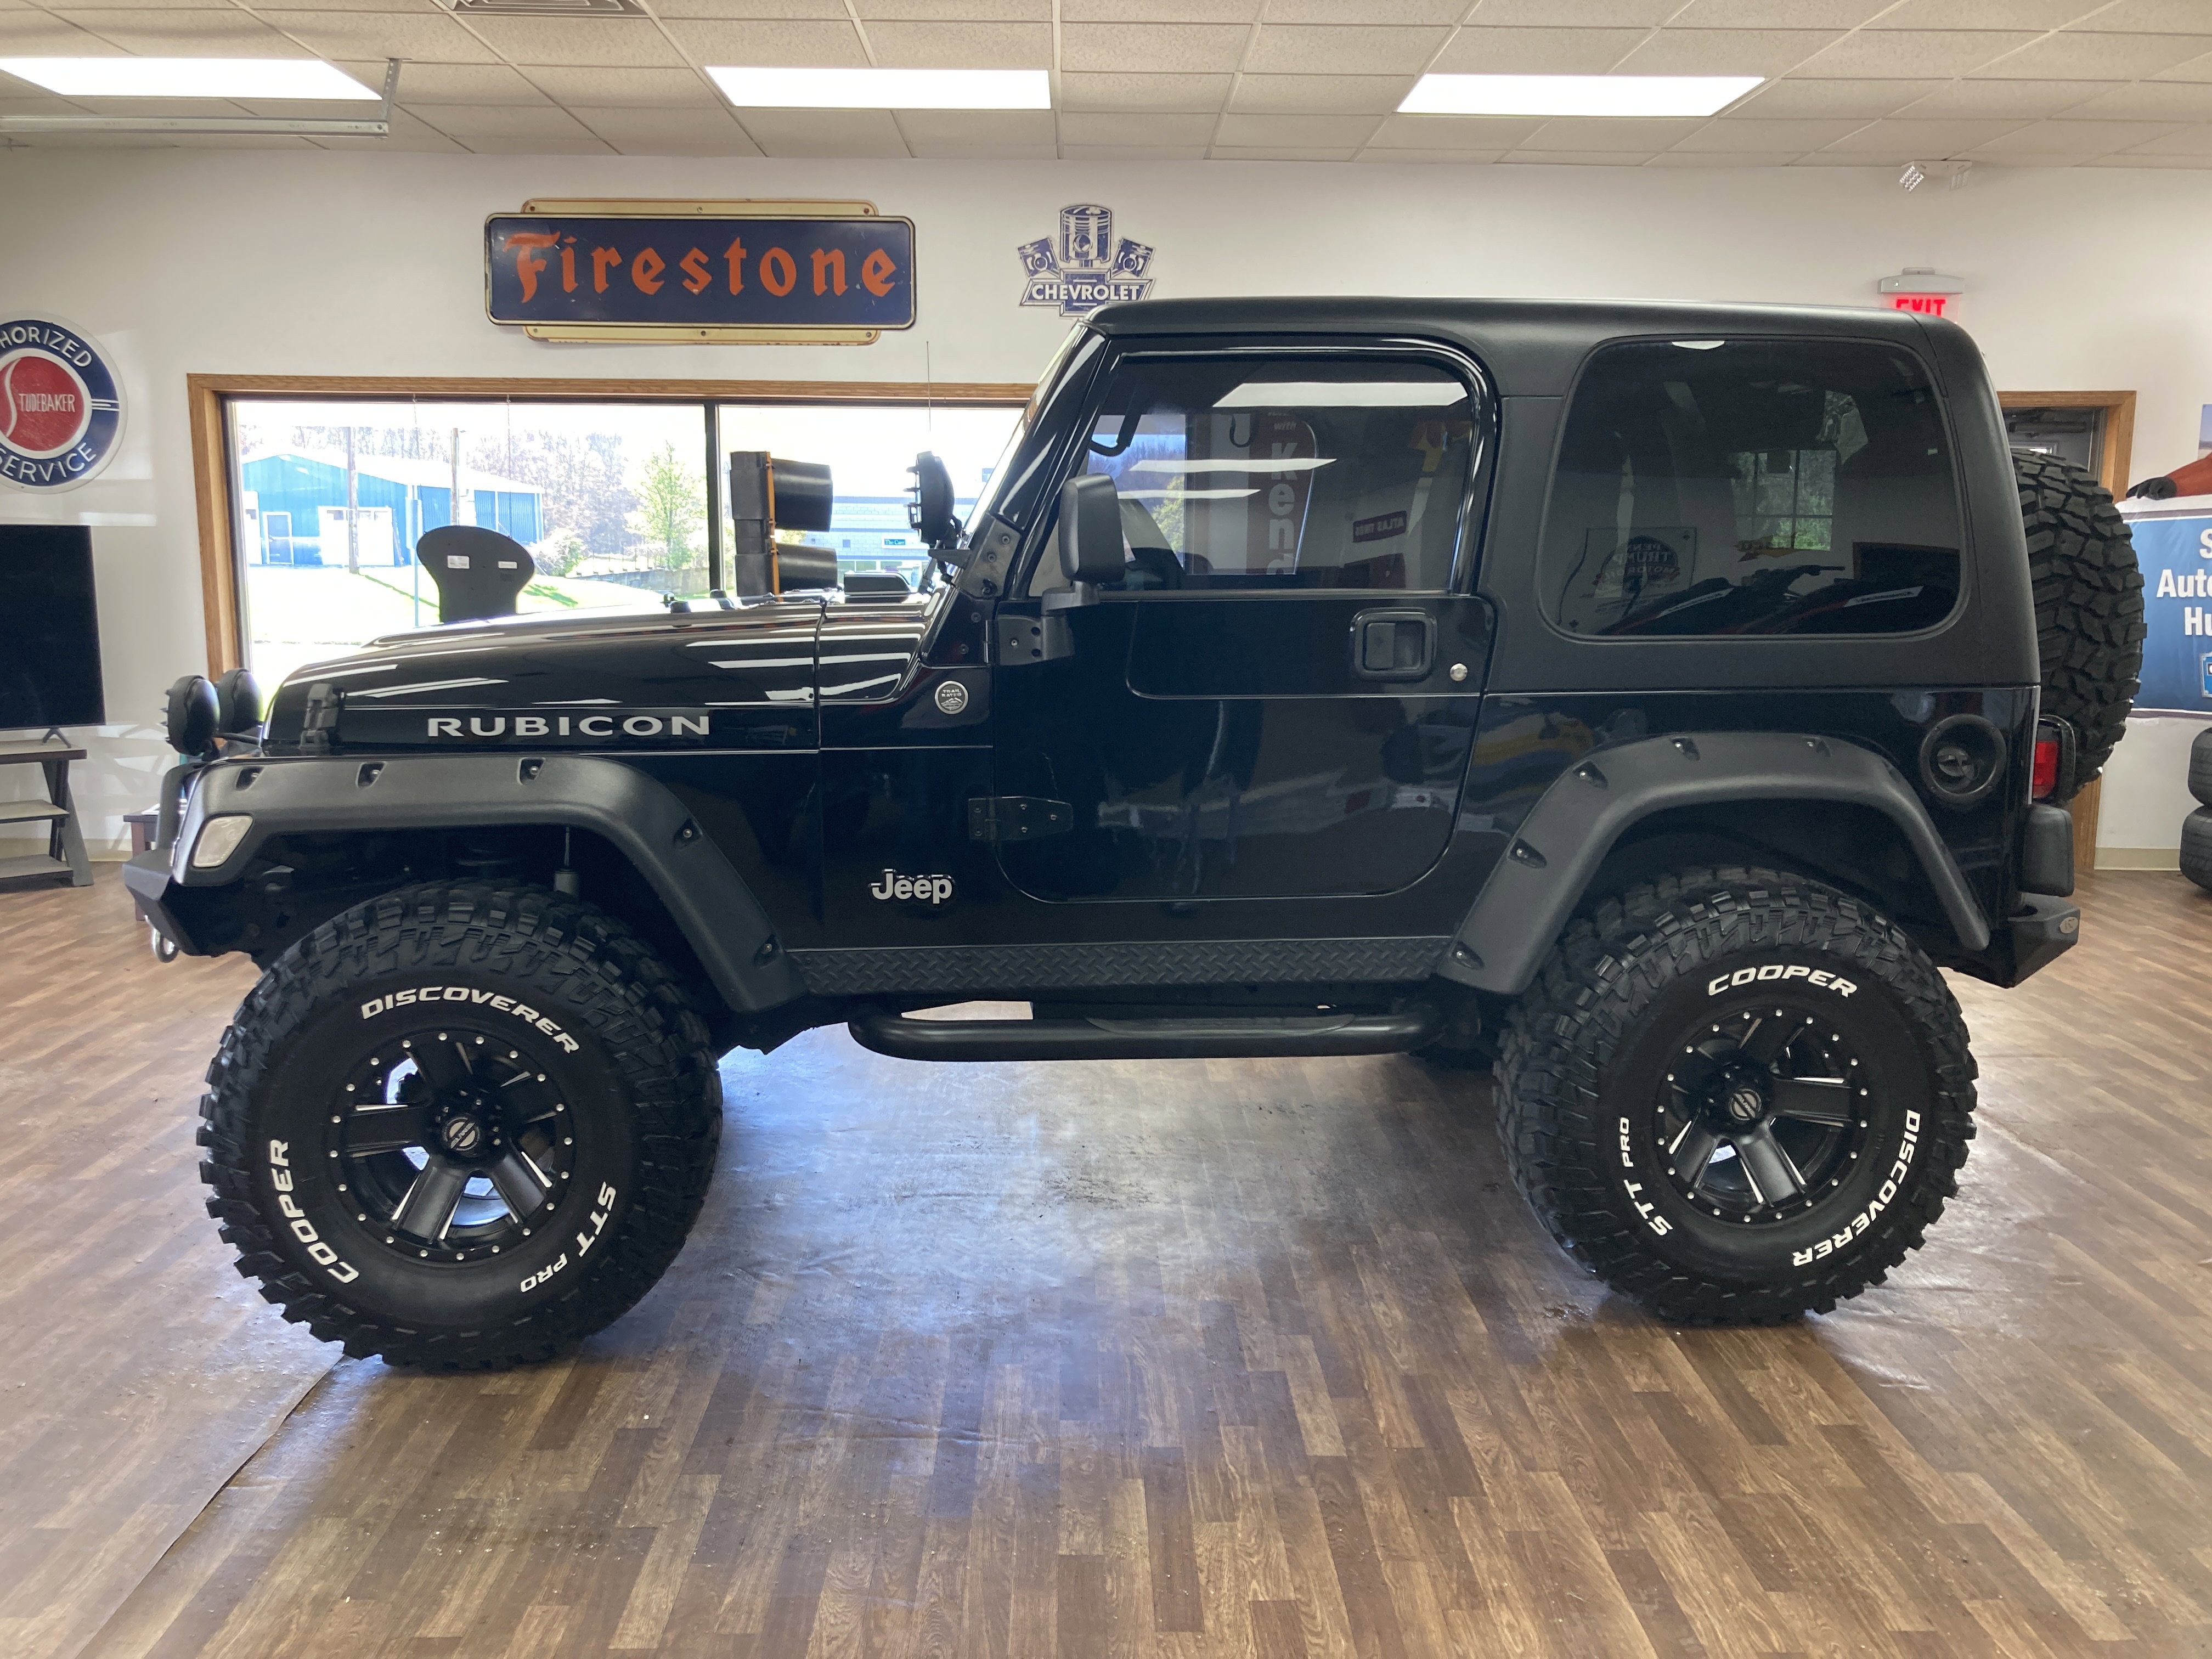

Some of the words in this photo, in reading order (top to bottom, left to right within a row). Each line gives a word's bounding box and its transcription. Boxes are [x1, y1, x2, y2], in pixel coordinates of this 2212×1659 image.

[503, 230, 899, 304] Firestone
[1031, 284, 1141, 301] CHEVROLET
[427, 715, 710, 737] RUBICON
[868, 868, 954, 905] Jeep
[1708, 964, 1858, 998] COOPER
[361, 986, 580, 1055] DISCOVERER
[1617, 1117, 1634, 1168] PRO
[269, 1139, 359, 1284] COOPER
[1624, 1177, 1675, 1237] STT
[1792, 1109, 1922, 1268] DISCOVERER
[577, 1181, 617, 1259] STT
[520, 1252, 568, 1293] PRO
